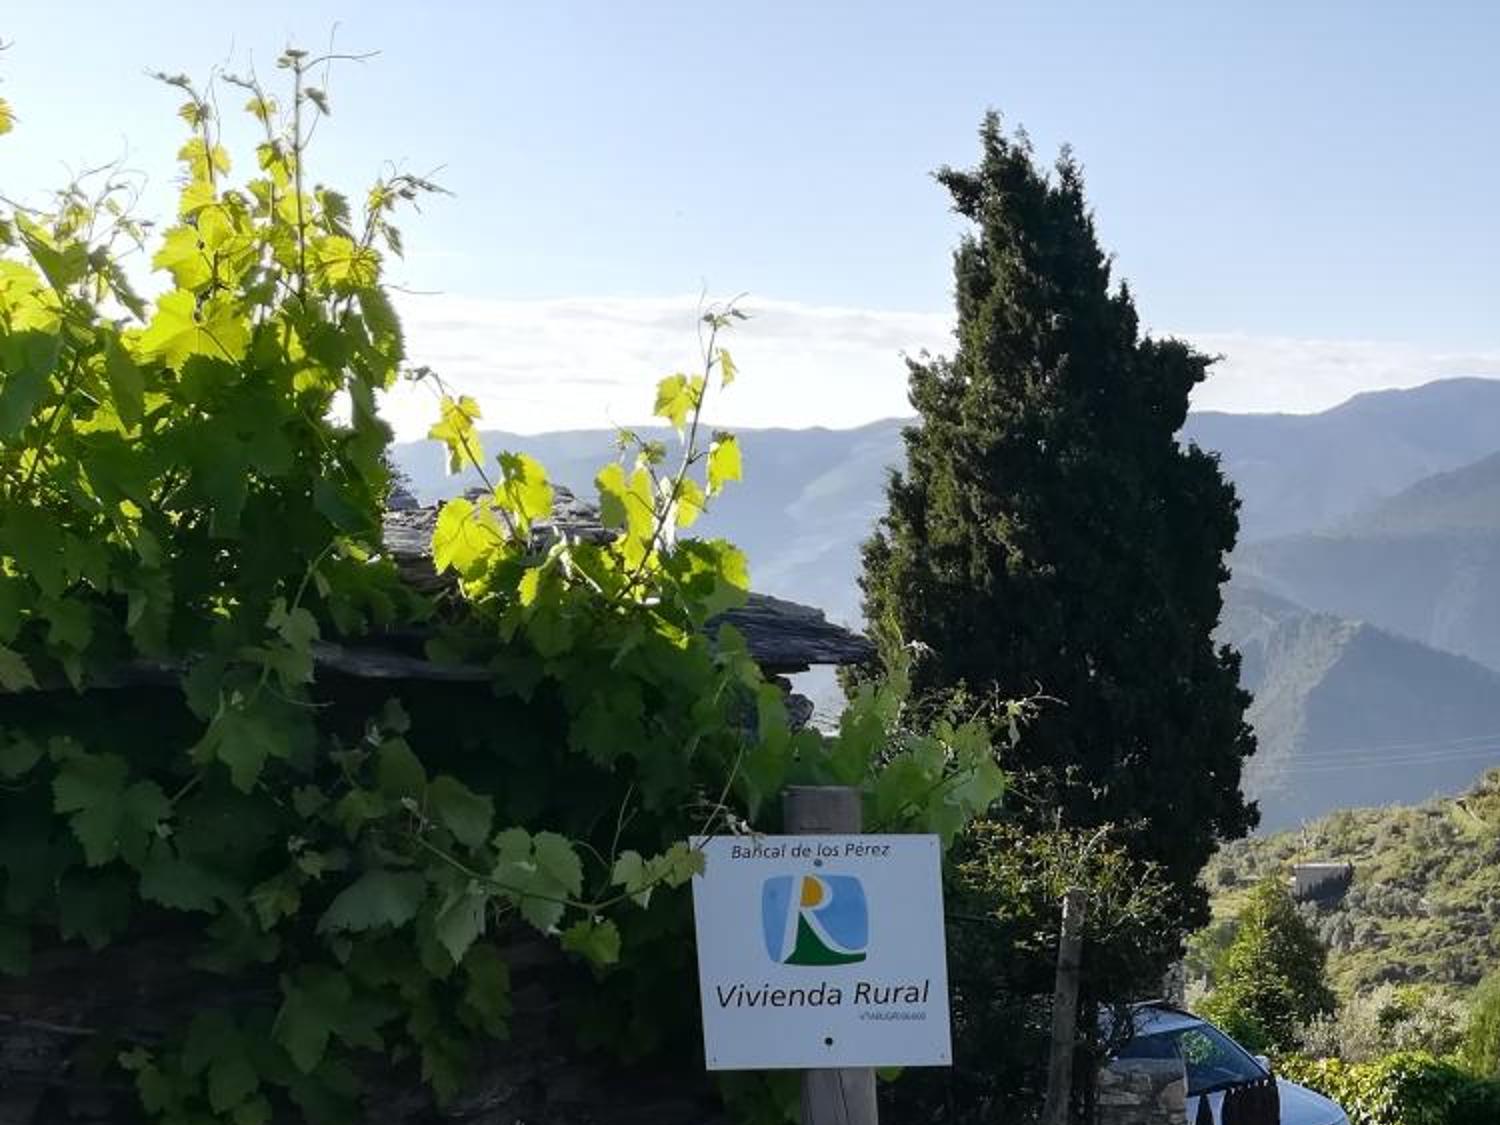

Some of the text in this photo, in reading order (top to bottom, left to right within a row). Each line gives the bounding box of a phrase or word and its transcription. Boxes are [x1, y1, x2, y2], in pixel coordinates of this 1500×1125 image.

[731, 841, 891, 859] Bancal de los Pérez
[716, 980, 930, 1008] Vivienda Rural
